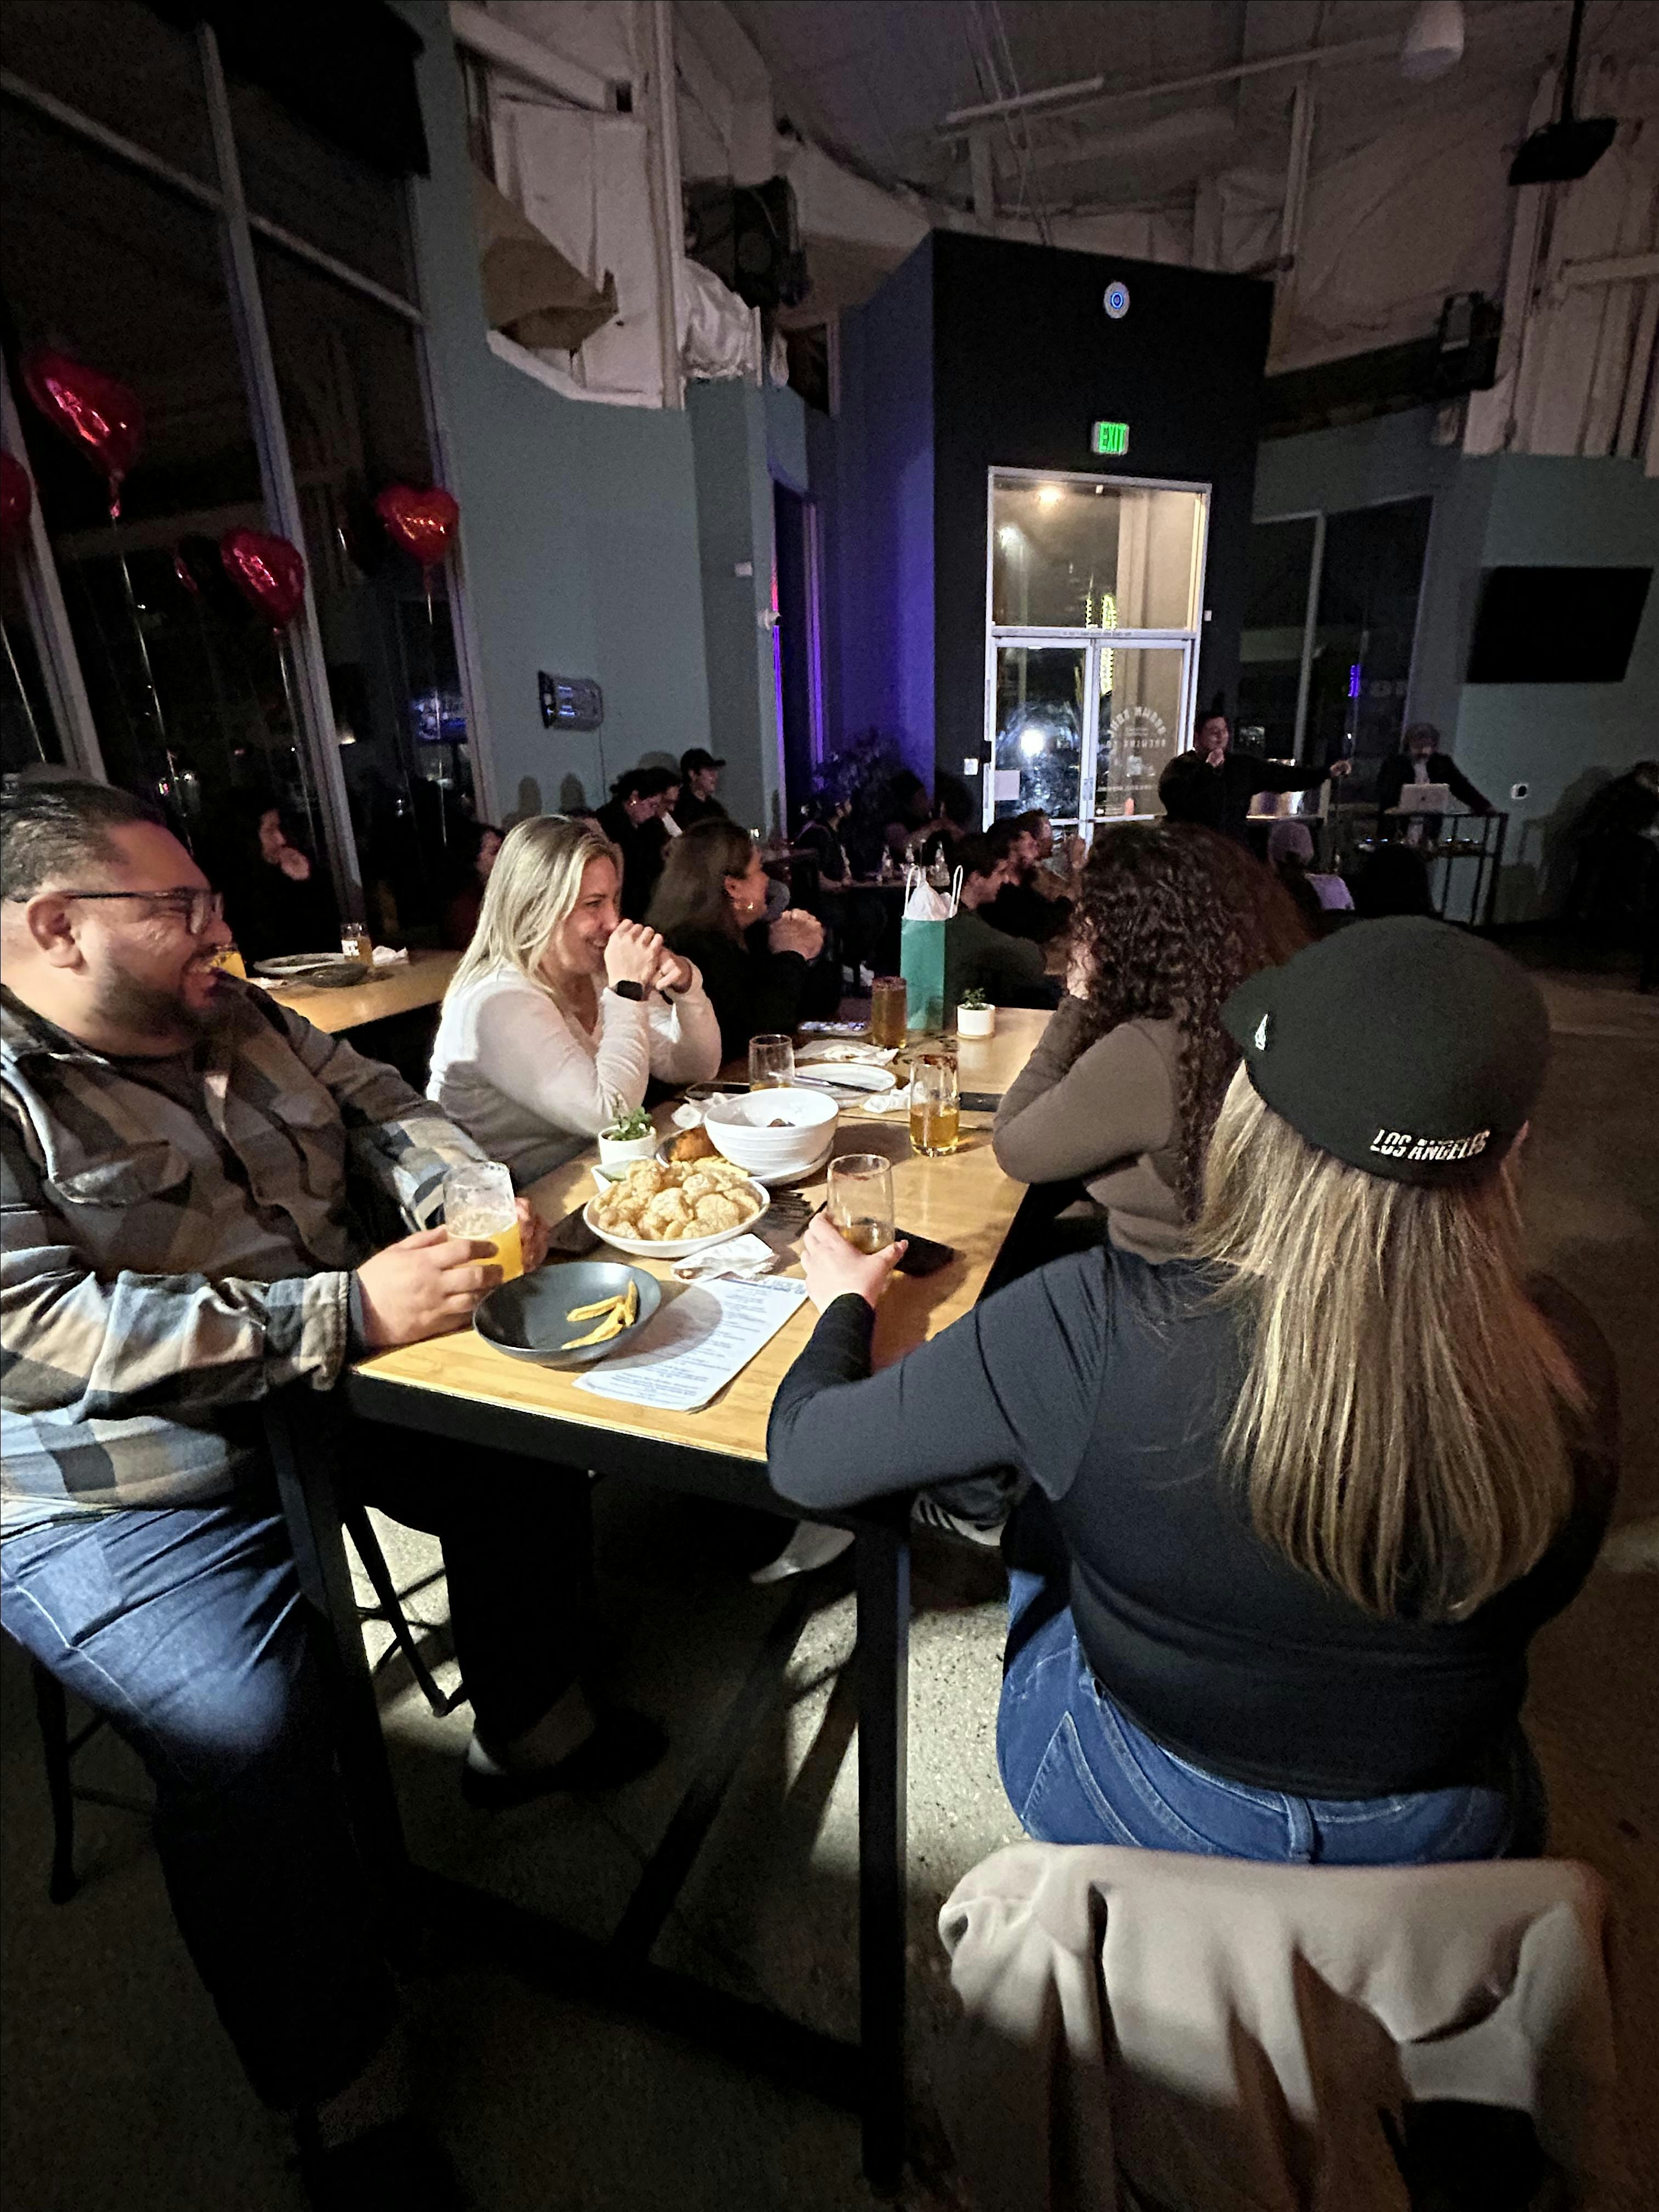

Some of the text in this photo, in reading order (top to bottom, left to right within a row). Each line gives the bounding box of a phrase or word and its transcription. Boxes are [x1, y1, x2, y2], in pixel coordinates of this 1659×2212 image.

[1099, 423, 1126, 453] EXIT
[1370, 1129, 1491, 1161] LOS ANGELES
